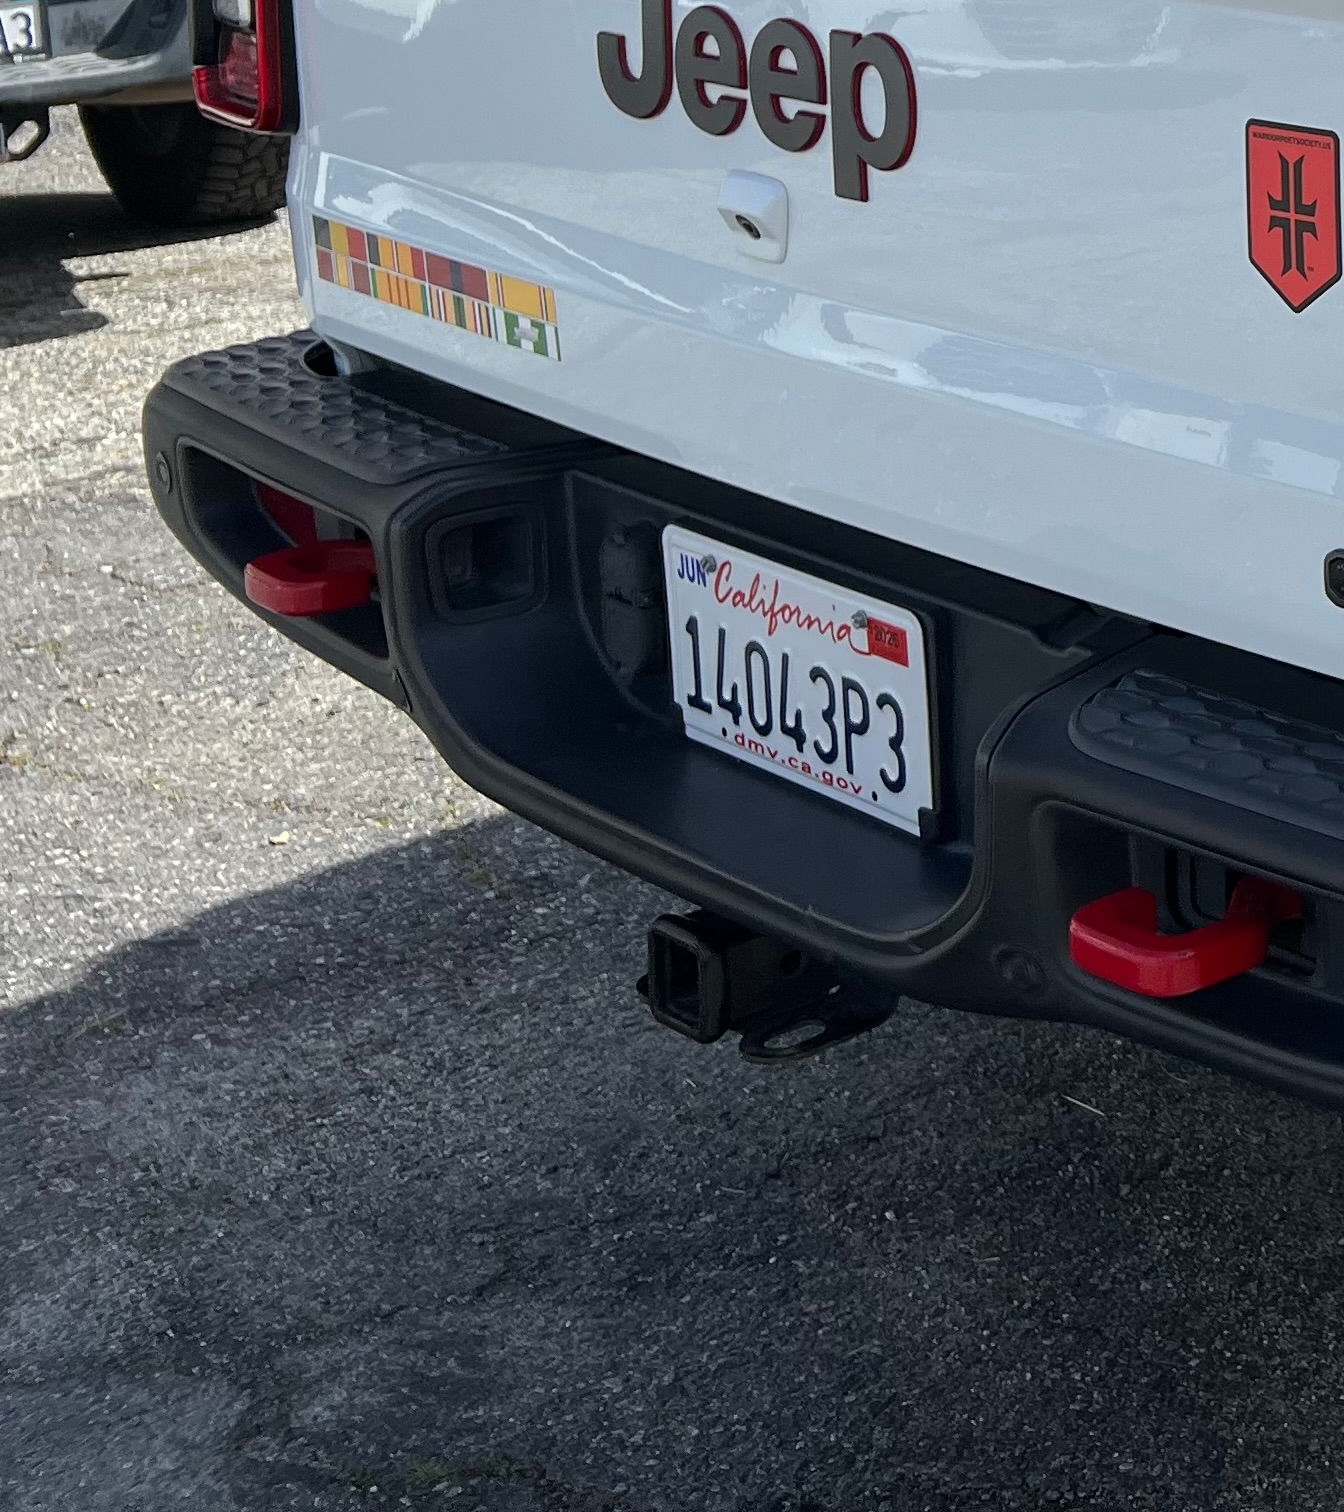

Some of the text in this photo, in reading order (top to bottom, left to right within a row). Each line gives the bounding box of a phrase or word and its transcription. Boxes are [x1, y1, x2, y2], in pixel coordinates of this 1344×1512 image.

[677, 552, 707, 587] JUN
[714, 559, 872, 656] California
[685, 614, 907, 795] 14043P3
[734, 731, 863, 795] dmv.ca.gov
